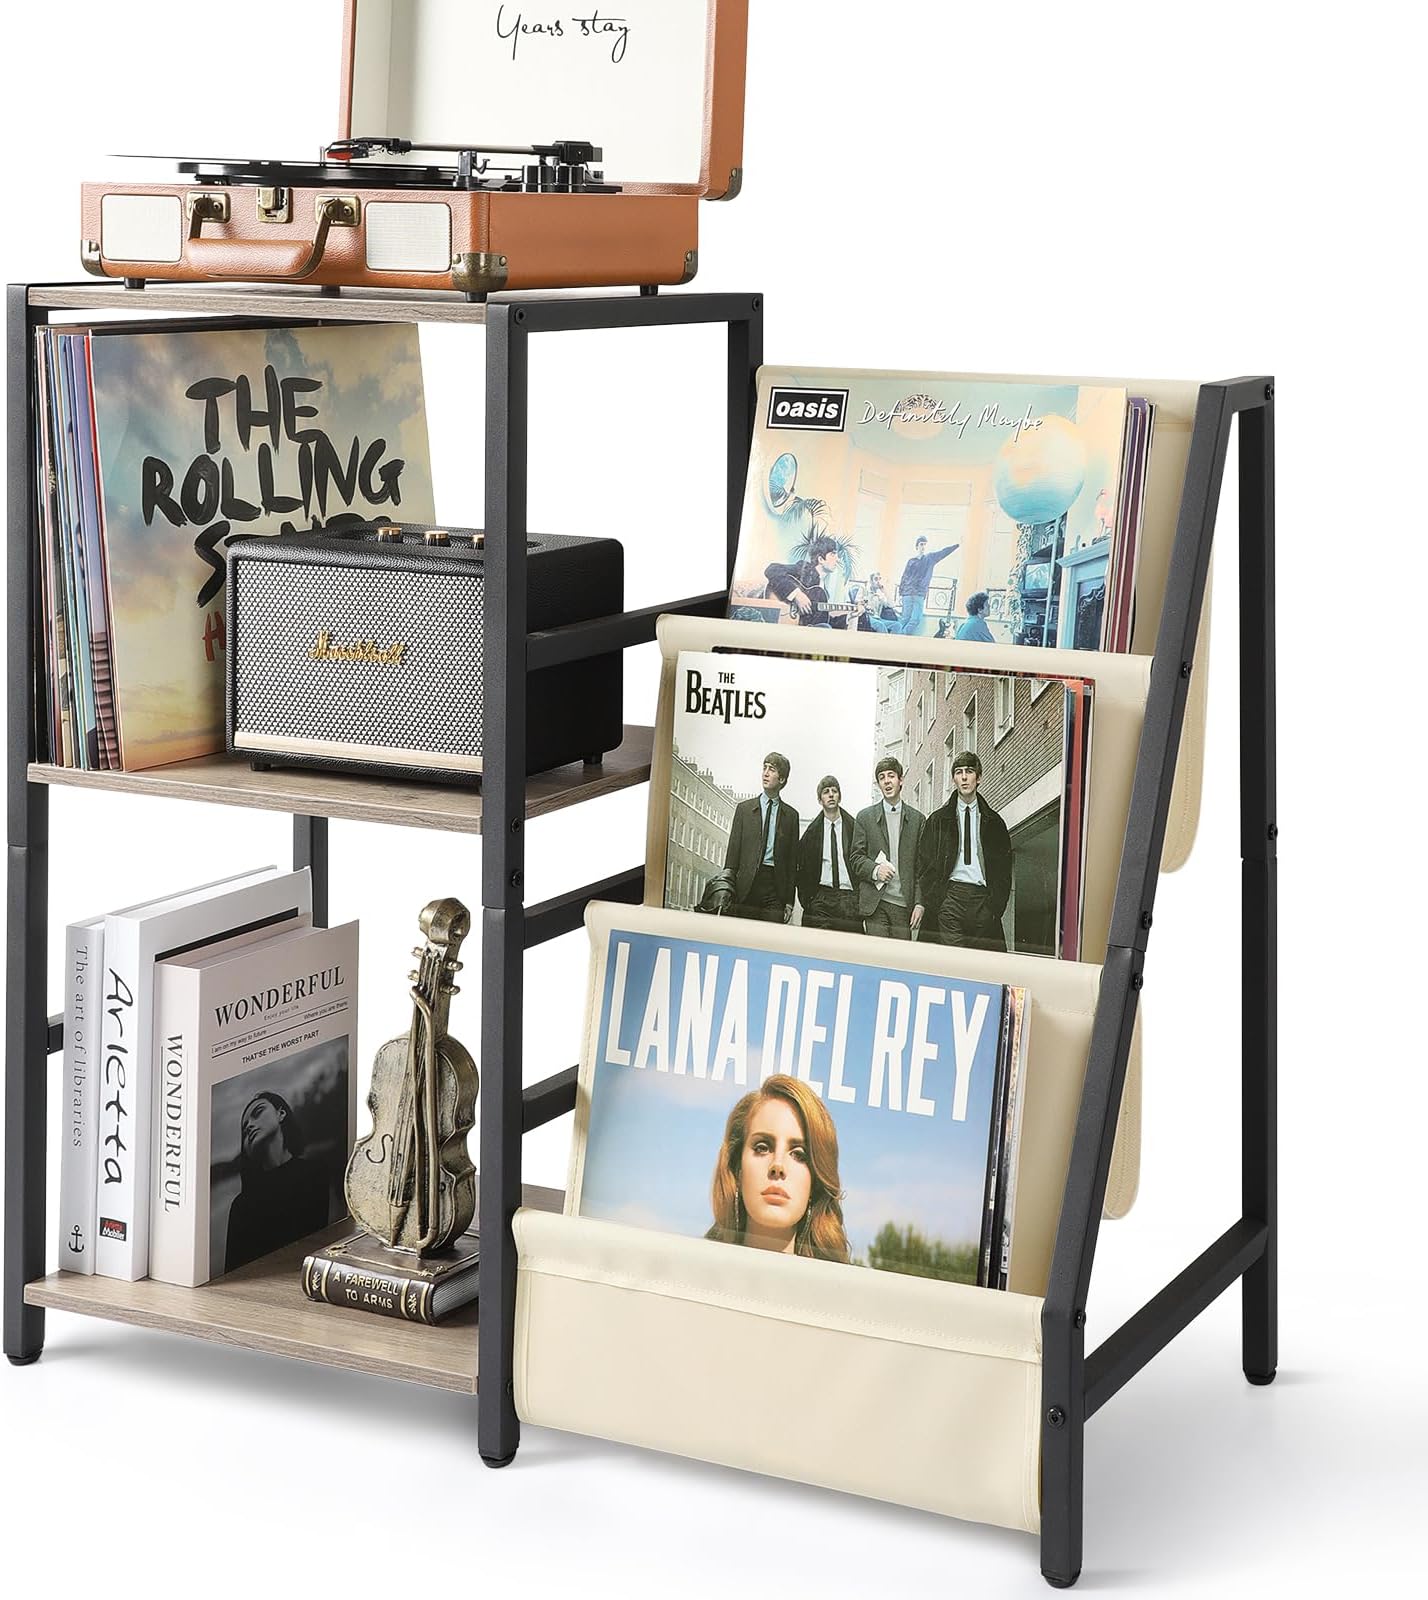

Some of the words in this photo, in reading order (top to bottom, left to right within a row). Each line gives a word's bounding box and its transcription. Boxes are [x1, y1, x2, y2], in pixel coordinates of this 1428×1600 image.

[497, 4, 564, 61] Years
[572, 9, 631, 63] stay
[186, 364, 323, 454] THE
[775, 396, 840, 420] oasis
[857, 399, 970, 440] Definitely
[976, 403, 1043, 442] Maybe
[141, 434, 405, 528] ROLLING
[685, 669, 767, 724] BEATLES
[718, 671, 735, 684] THE
[75, 945, 88, 985] The
[74, 993, 85, 1022] art
[213, 965, 345, 1029] WONDERFUL
[74, 1030, 87, 1054] of
[268, 1044, 280, 1054] THE
[281, 1035, 303, 1049] WORST
[303, 1029, 319, 1041] PART
[605, 941, 749, 1085] LANA
[760, 964, 857, 1104] DEL
[868, 980, 990, 1122] REY
[73, 1060, 87, 1147] libraries
[164, 1033, 183, 1213] WONDERFUL
[332, 1271, 342, 1282] A
[344, 1273, 400, 1296] FAREWELL
[345, 1289, 358, 1301] TO
[363, 1293, 394, 1309] ARMS
